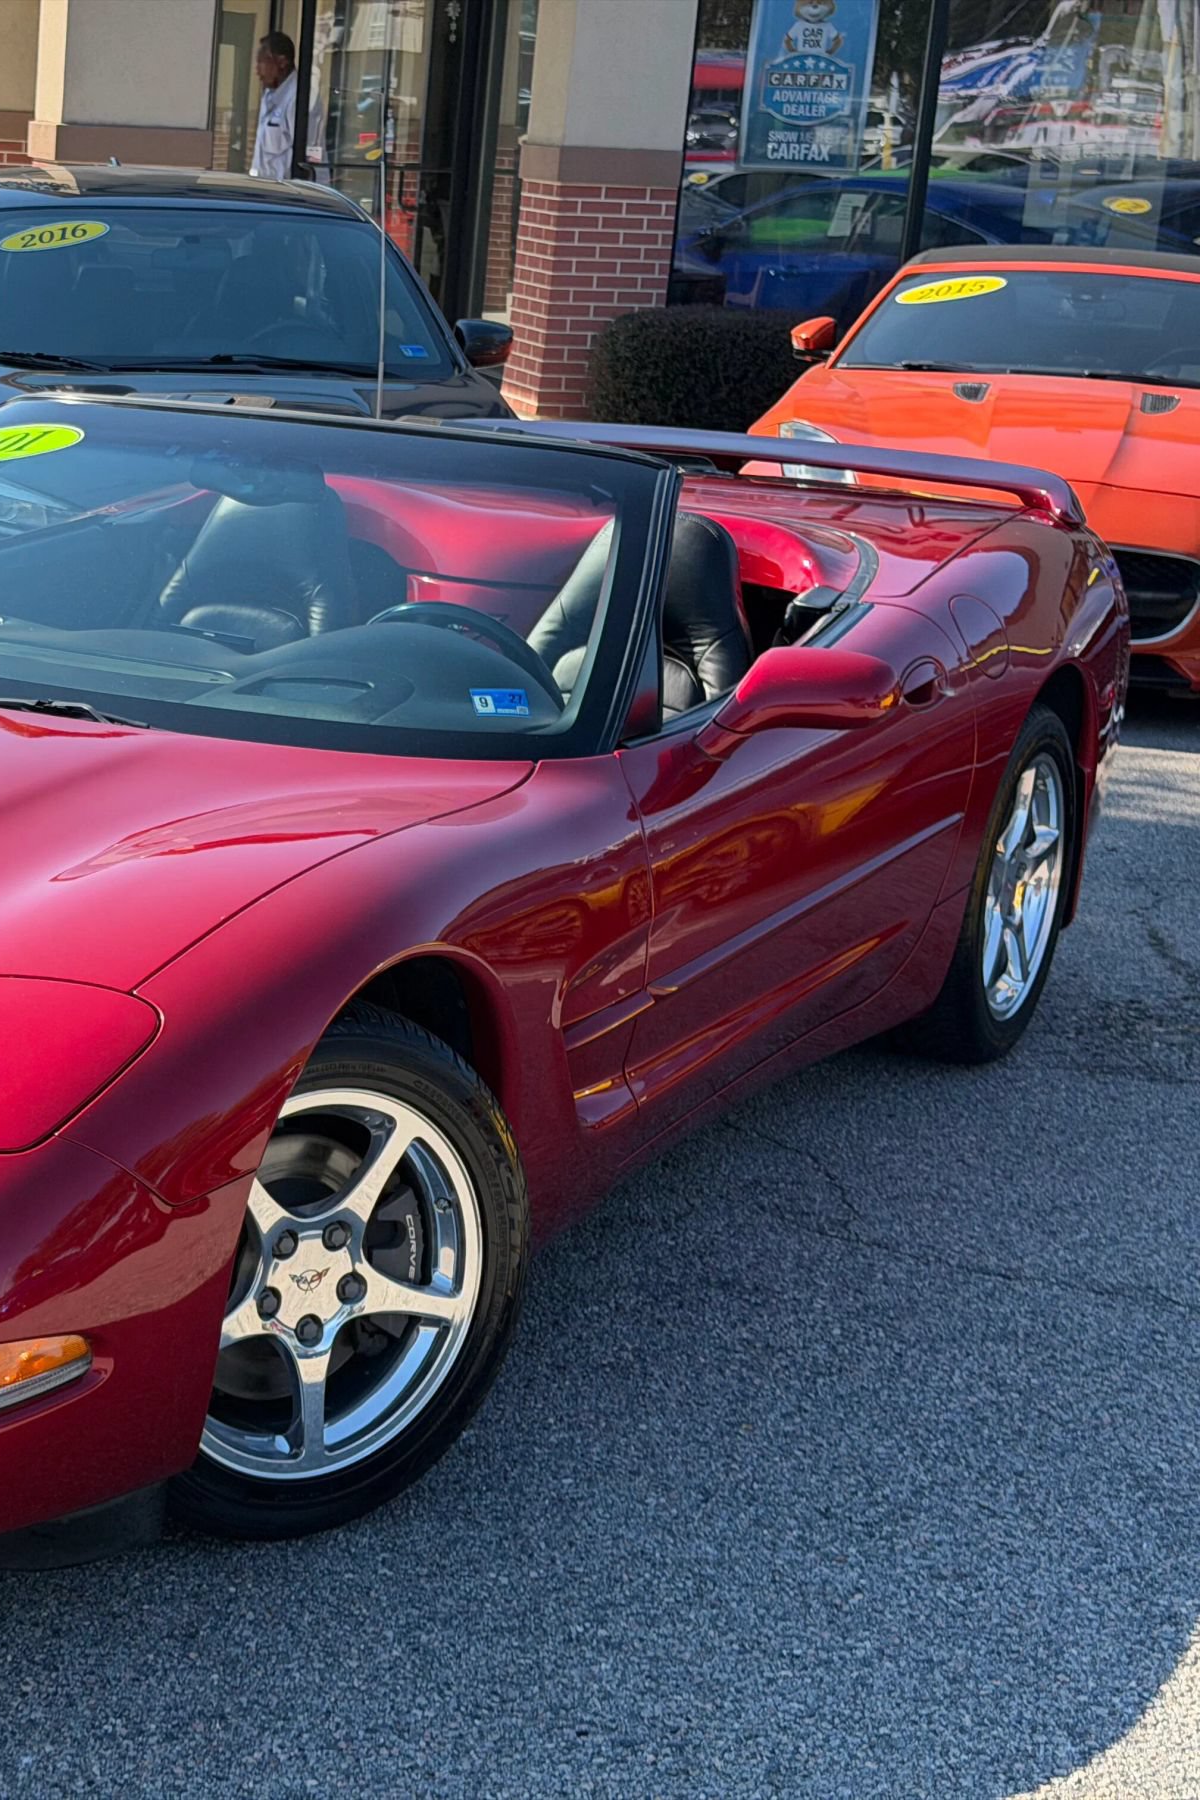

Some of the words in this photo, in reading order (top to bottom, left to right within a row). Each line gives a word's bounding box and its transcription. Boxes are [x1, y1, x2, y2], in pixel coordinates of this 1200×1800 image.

[802, 27, 824, 39] CAR
[802, 39, 822, 49] FOX
[770, 74, 845, 89] CARFAX
[773, 90, 840, 104] ADVANTAGE
[783, 104, 827, 117] DEALER
[767, 142, 833, 162] CARFAX
[21, 223, 87, 248] 2016
[918, 281, 987, 300] 2015
[479, 696, 489, 708] 9
